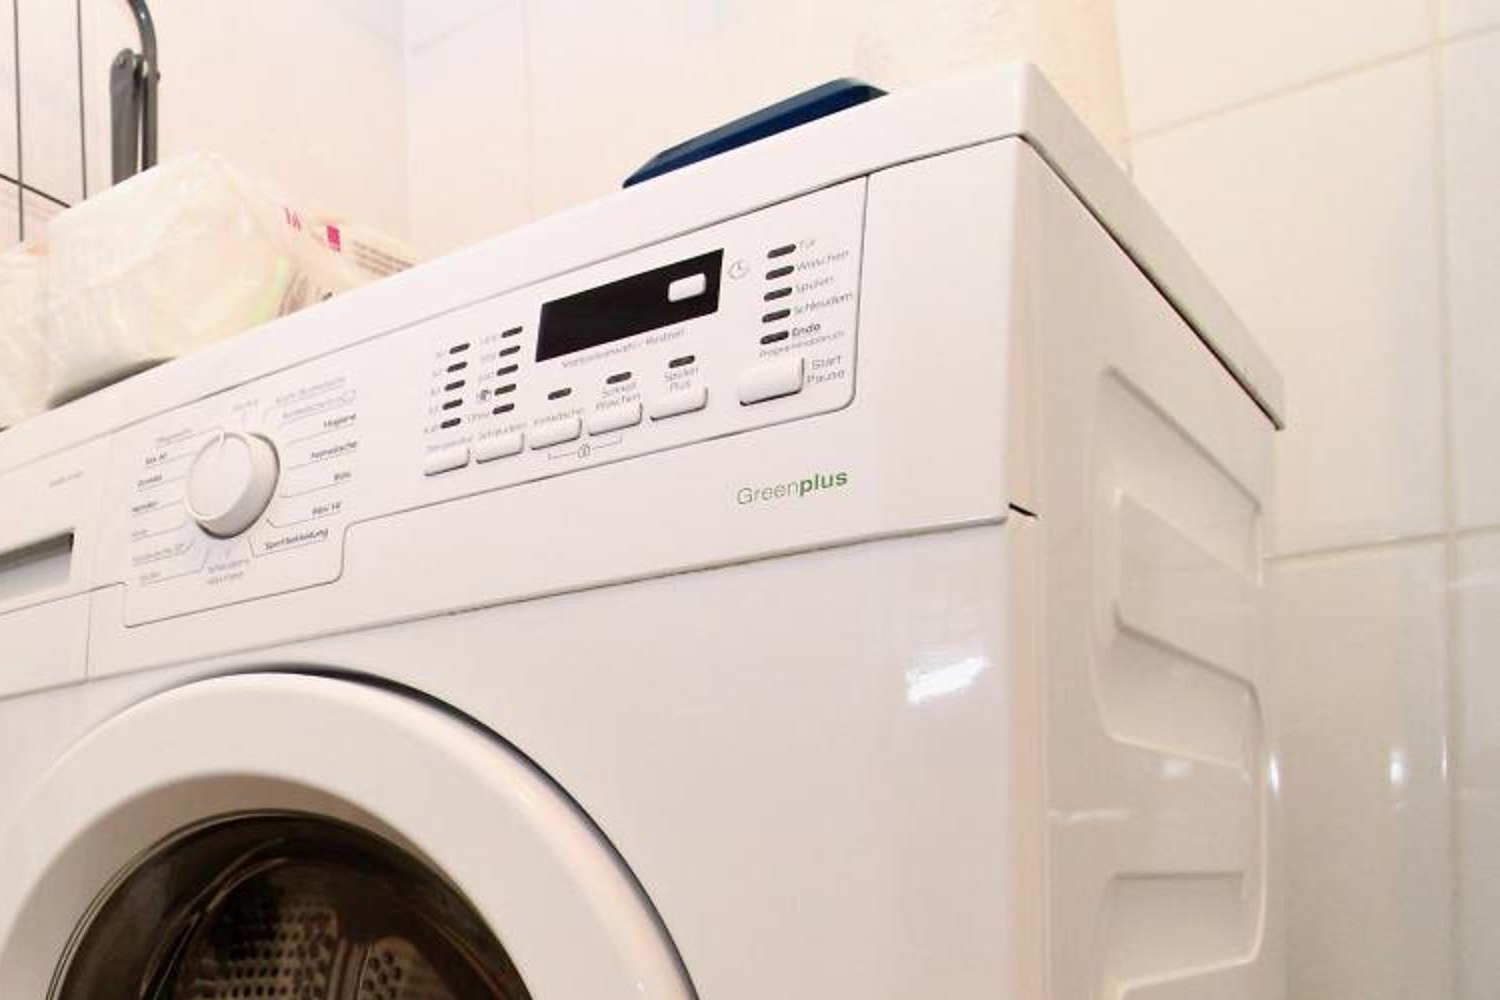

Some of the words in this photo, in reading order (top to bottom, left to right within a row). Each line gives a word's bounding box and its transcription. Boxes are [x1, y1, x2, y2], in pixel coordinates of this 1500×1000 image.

[791, 323, 821, 338] Ende
[811, 355, 842, 370] Start
[806, 370, 845, 384] Pause
[736, 471, 849, 505] Greenplus
